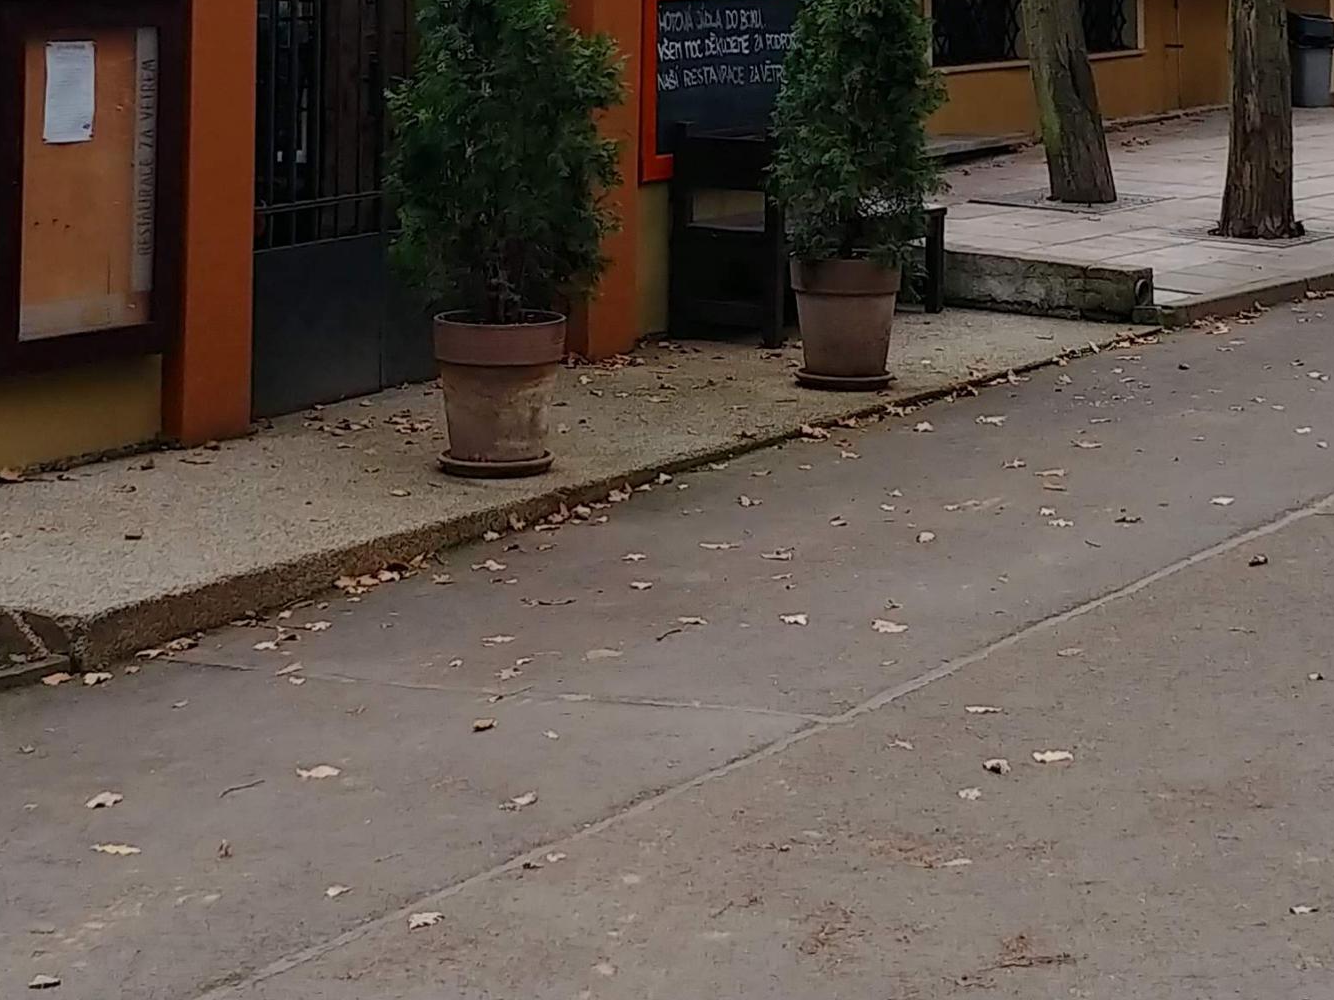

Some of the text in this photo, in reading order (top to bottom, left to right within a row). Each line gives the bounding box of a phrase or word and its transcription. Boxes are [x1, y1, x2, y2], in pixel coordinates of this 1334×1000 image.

[725, 9, 738, 29] DO
[657, 37, 683, 62] VŠEM
[684, 39, 703, 59] MOC
[754, 33, 764, 52] ZA
[749, 65, 759, 83] ZA
[138, 129, 154, 150] ZA
[137, 158, 154, 256] RESTAURACE
